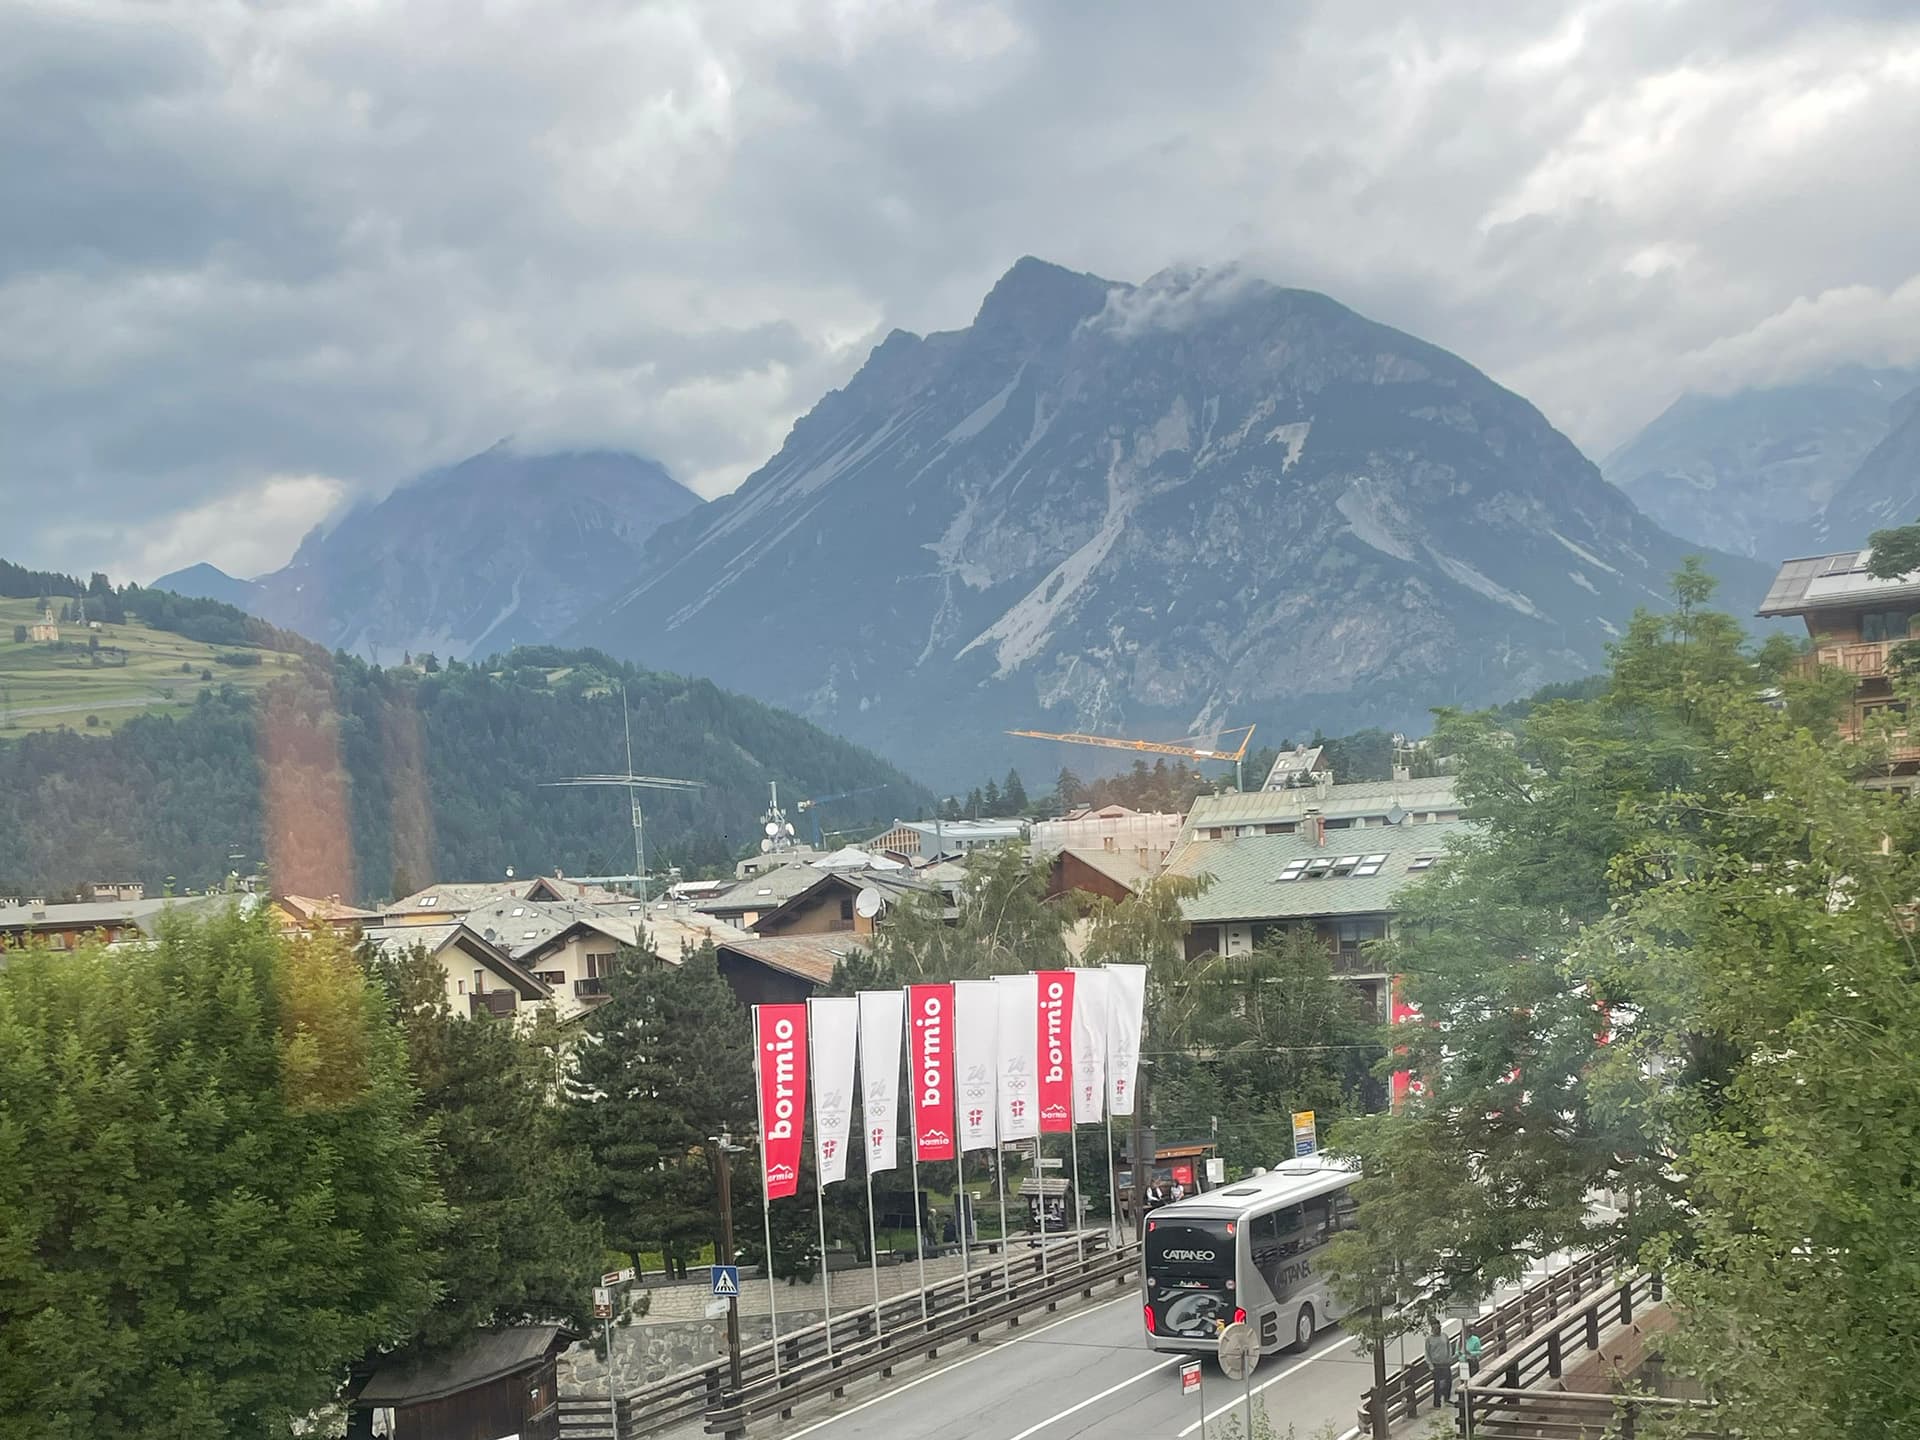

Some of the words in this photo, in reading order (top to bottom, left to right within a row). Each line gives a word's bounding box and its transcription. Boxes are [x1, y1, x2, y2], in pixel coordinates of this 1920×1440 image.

[766, 1018, 794, 1141] bormio
[916, 997, 941, 1107] bormio
[1040, 982, 1064, 1083] bormio
[767, 1170, 794, 1182] ormio
[1162, 1249, 1216, 1261] CATTANEO
